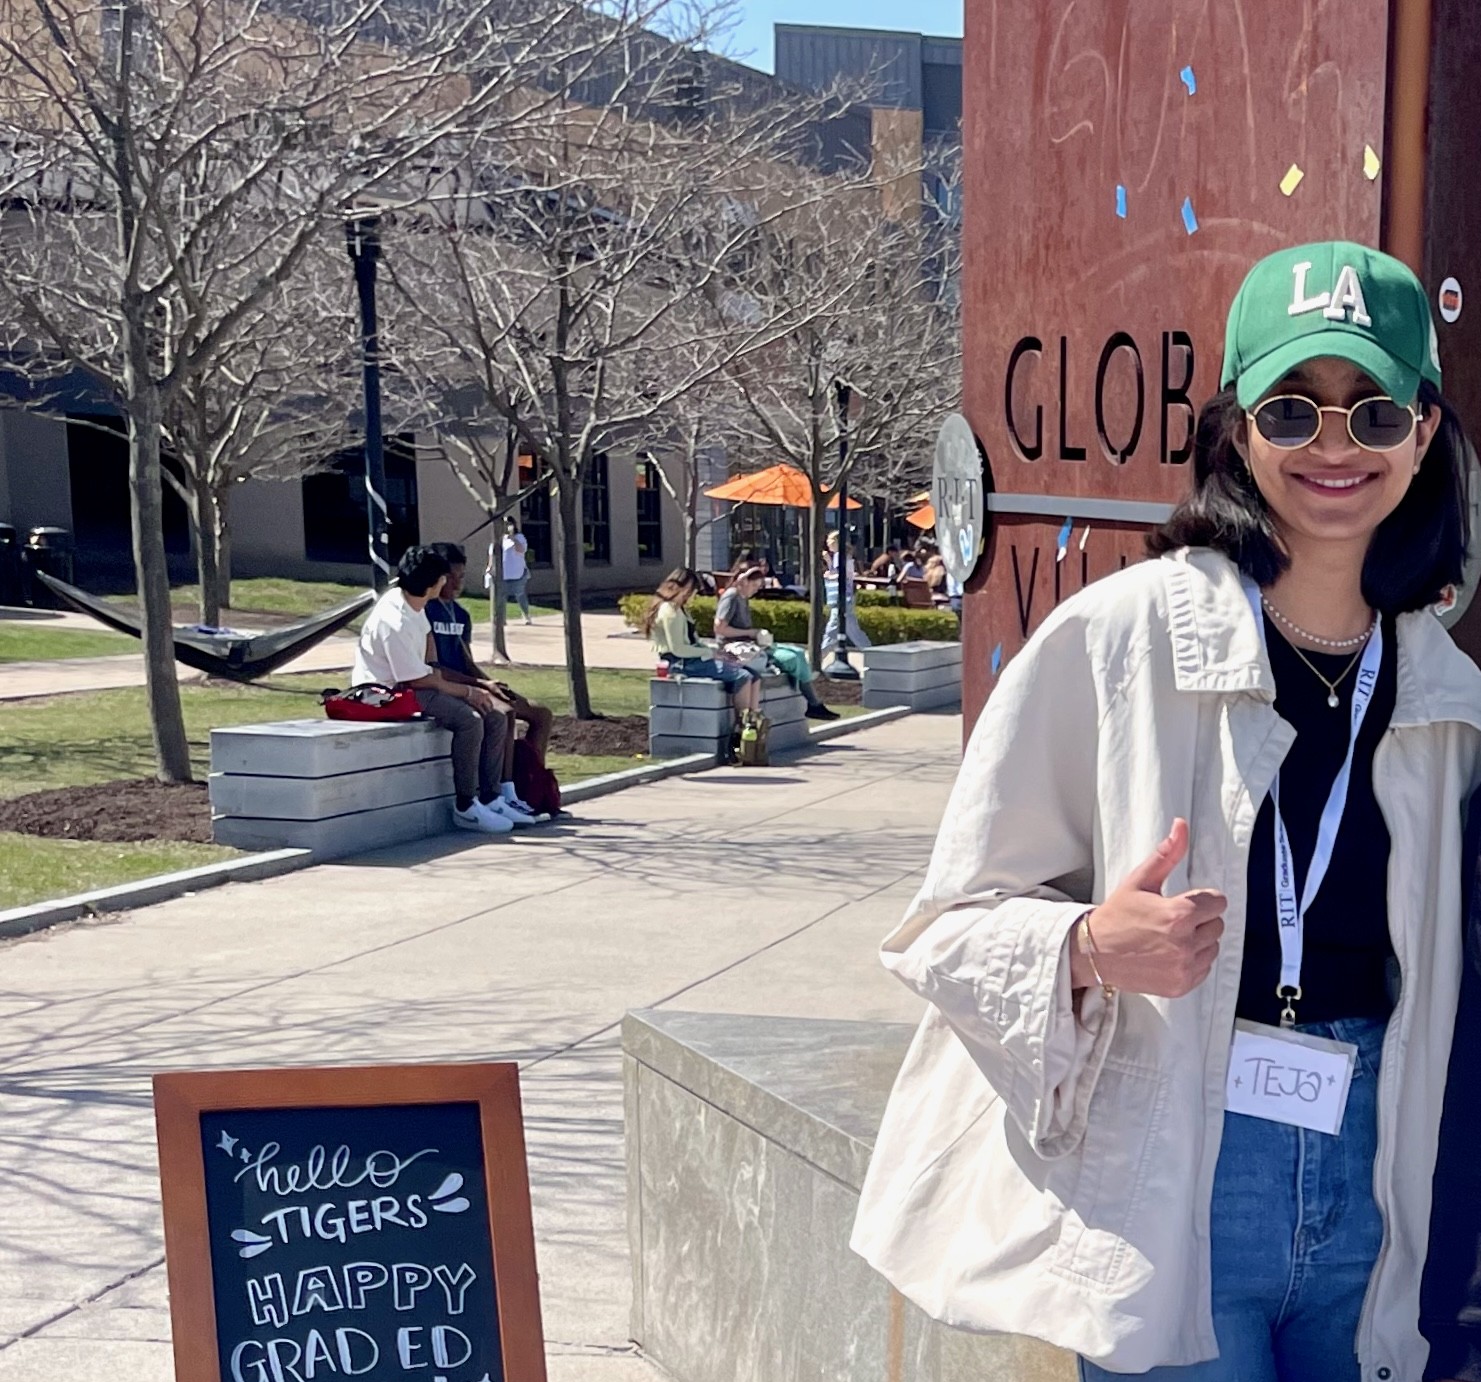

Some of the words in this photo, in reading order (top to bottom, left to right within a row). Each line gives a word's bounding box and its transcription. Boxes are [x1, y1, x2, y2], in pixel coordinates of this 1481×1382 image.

[1287, 261, 1372, 328] LA
[1004, 330, 1195, 466] GLOB
[1279, 893, 1296, 928] RIT
[234, 1141, 440, 1196] hello
[261, 1194, 429, 1244] TIGERS
[246, 1261, 477, 1328] HAPPY
[397, 1325, 473, 1370] ED
